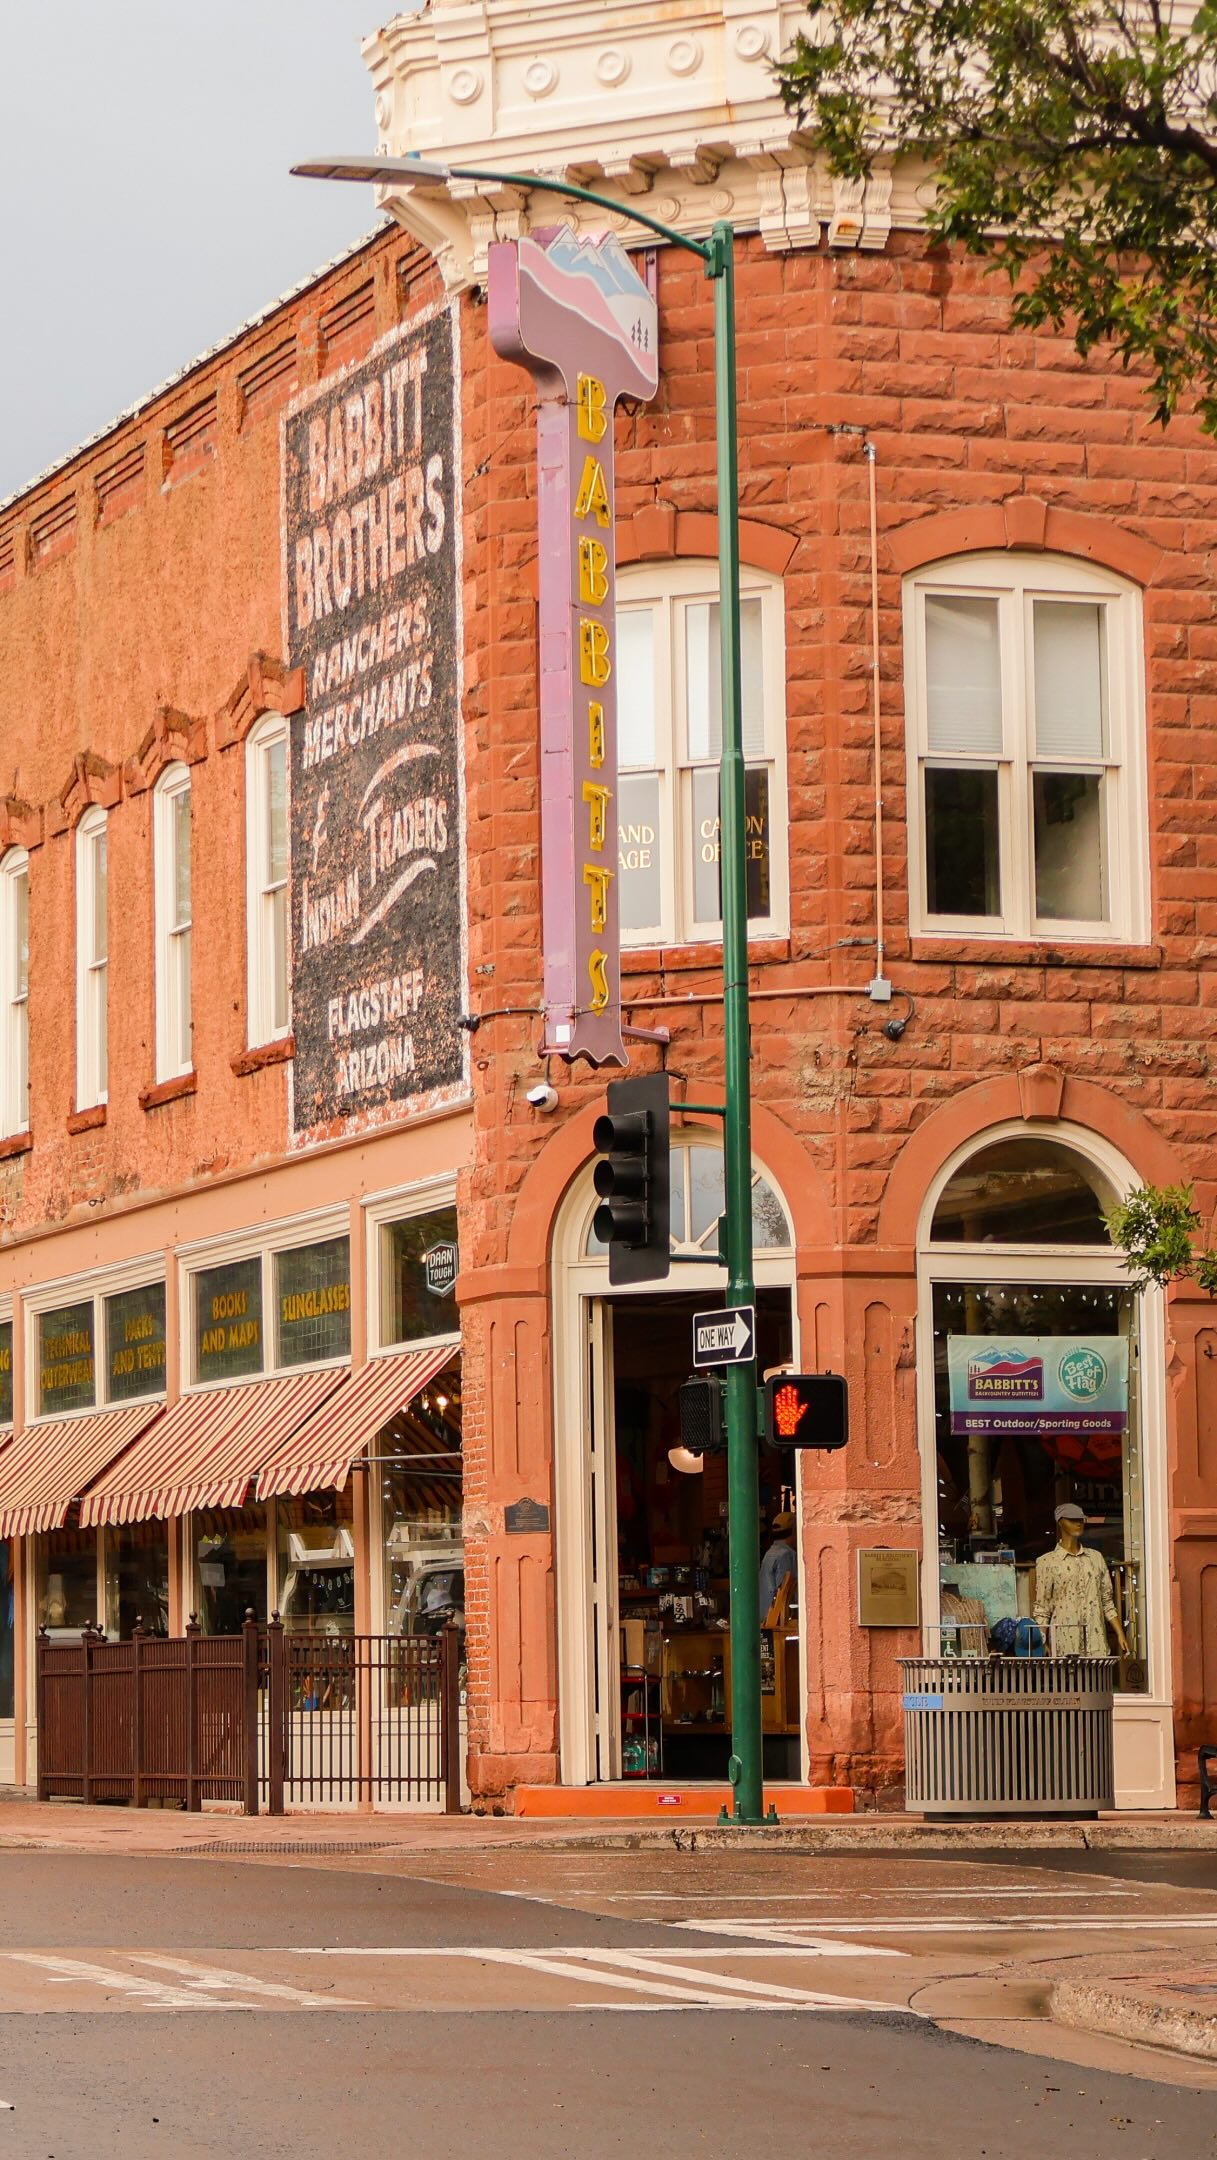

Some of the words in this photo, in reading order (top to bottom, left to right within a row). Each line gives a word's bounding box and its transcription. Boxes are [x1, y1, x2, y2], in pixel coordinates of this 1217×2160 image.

[308, 347, 428, 512] BABBITT
[295, 453, 446, 630] BROTHERS
[574, 371, 614, 1017] BABBITTS
[303, 652, 434, 769] MERCHANTS
[301, 866, 360, 953] INDIAN
[363, 796, 447, 888] TRADERS
[328, 967, 424, 1041] FLAGSTAFF
[335, 1034, 415, 1096] ARIZONA
[429, 1249, 453, 1268] DARN
[429, 1265, 453, 1281] TOUGH
[212, 1290, 249, 1321] BOOKS
[283, 1283, 350, 1322] SUNGLASSES
[202, 1327, 226, 1354] AND
[229, 1320, 260, 1348] MAPS
[700, 1329, 715, 1349] ONE
[717, 1326, 735, 1346] WAY
[112, 1349, 135, 1376] AND
[1065, 1354, 1094, 1376] Best
[1087, 1365, 1102, 1380] of
[975, 1379, 1039, 1390] BABBITT'S
[1065, 1371, 1097, 1393] Flag
[965, 1419, 991, 1428] BEST
[993, 1418, 1080, 1430] Outdoor/Sporting
[1082, 1418, 1112, 1428] Goods
